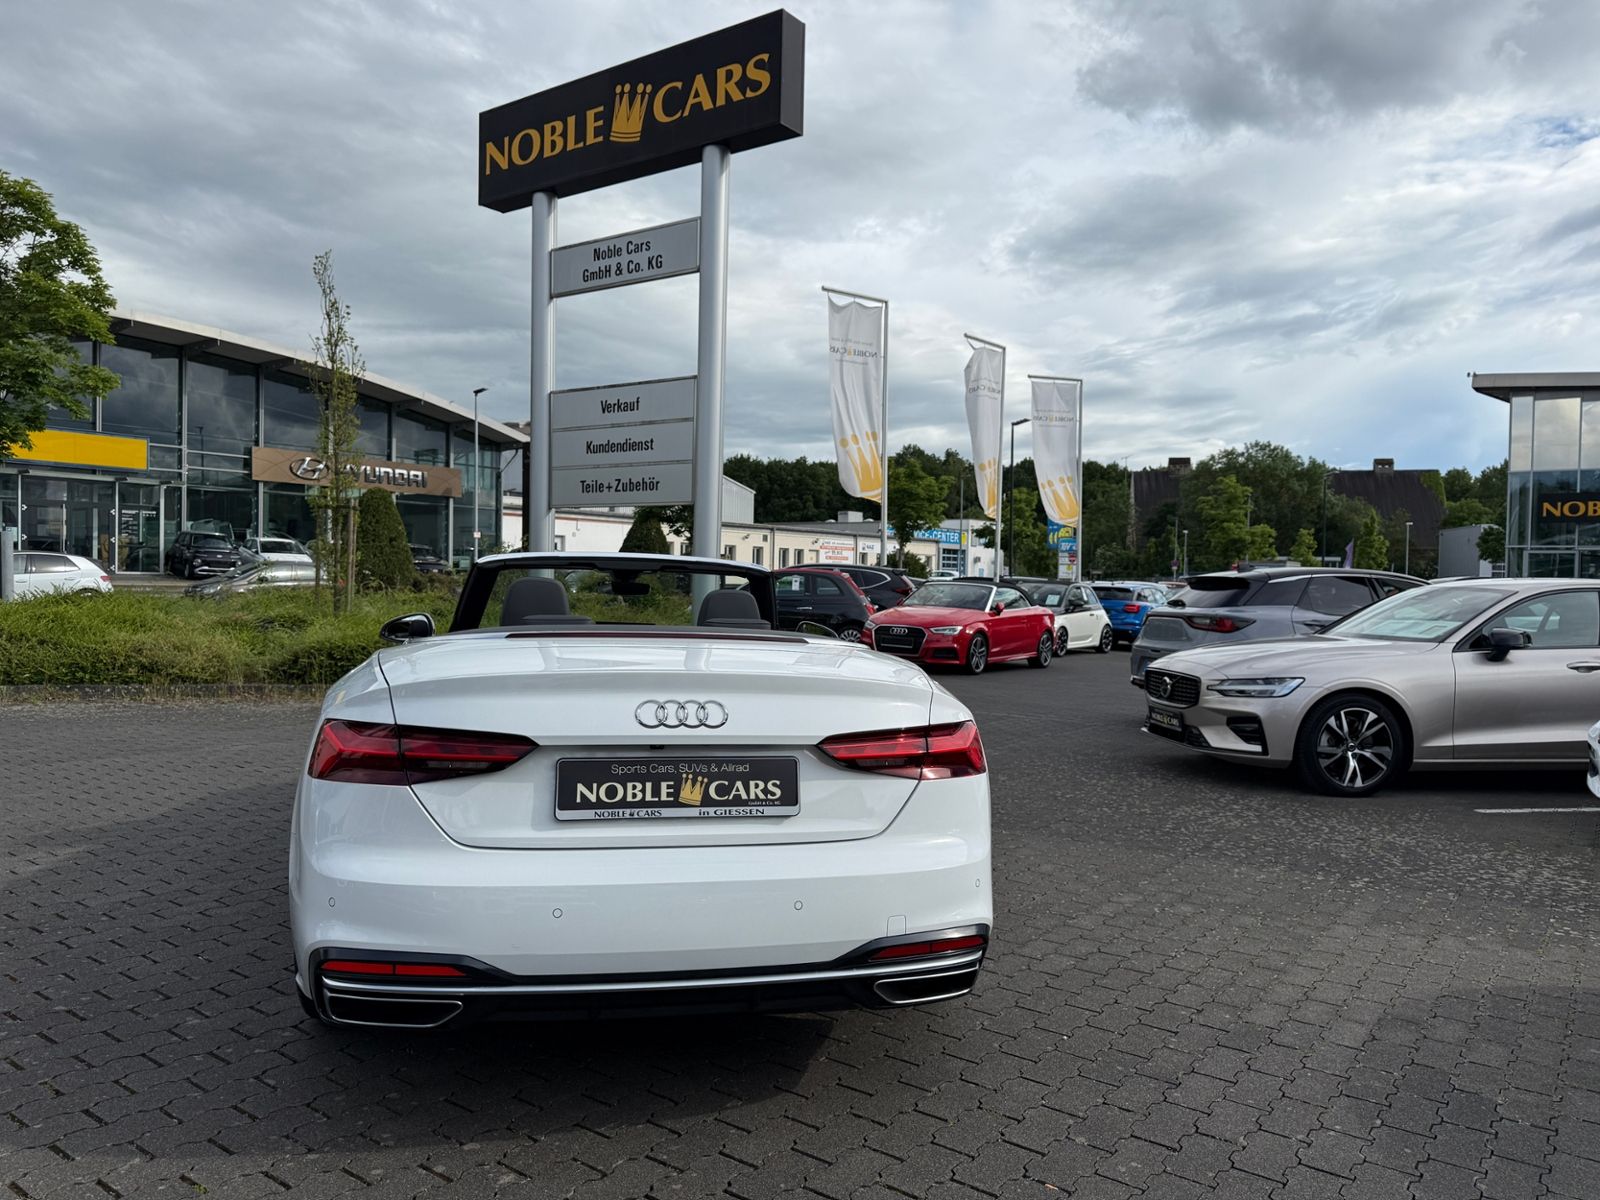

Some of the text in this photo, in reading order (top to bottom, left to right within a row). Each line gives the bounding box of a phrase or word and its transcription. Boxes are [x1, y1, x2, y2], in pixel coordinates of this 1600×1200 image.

[485, 53, 771, 176] NOBLE CARS
[593, 240, 651, 262] Noble Cars
[582, 255, 663, 283] GmbH & Co. KG
[600, 397, 640, 414] Verkauf
[586, 438, 654, 455] Kundendienst
[580, 477, 660, 494] Teile+Zubehör
[611, 764, 647, 775] Sports
[679, 763, 708, 773] SUVs
[710, 763, 719, 772] &
[720, 763, 750, 772] Allrad
[576, 780, 781, 803] NOBLE CARS
[594, 810, 629, 818] NOBLE
[714, 808, 765, 816] GIESSEN
